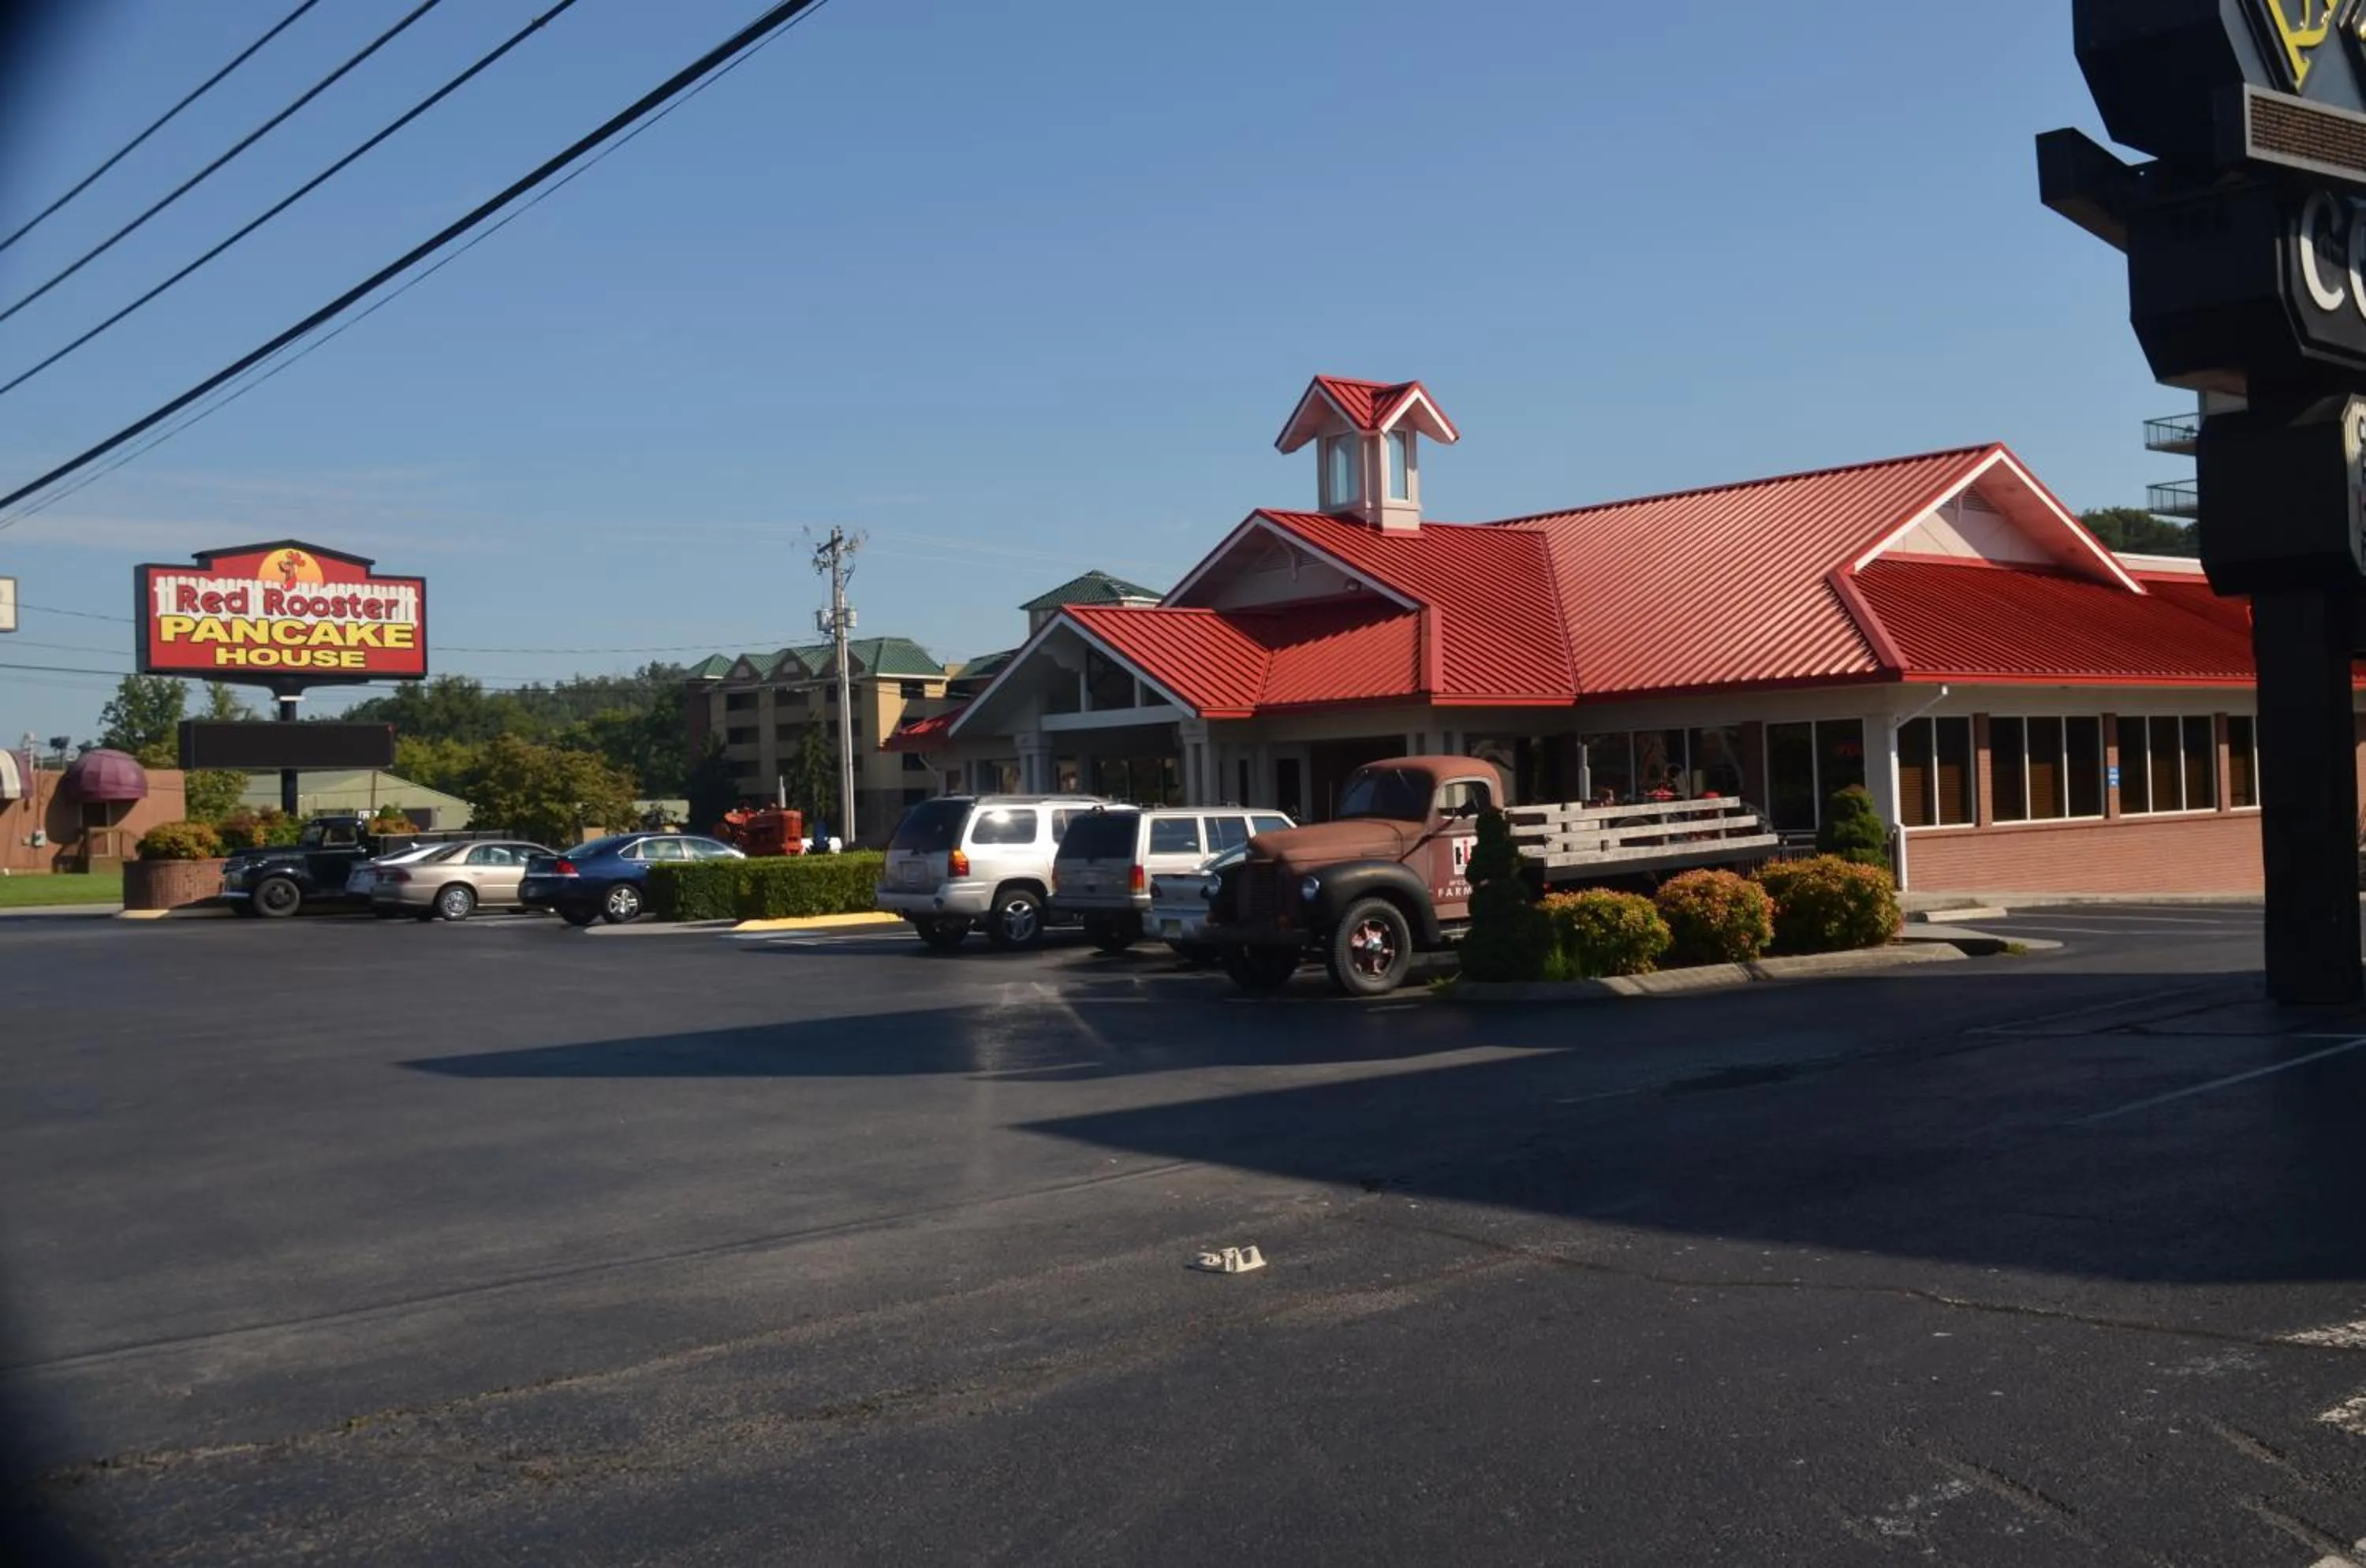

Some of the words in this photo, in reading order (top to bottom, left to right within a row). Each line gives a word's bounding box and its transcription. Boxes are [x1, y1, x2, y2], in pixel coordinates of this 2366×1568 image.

[177, 584, 248, 614] Red
[263, 588, 400, 620] Rooster
[160, 614, 415, 649] PANCAKE
[215, 647, 366, 669] HOUSE
